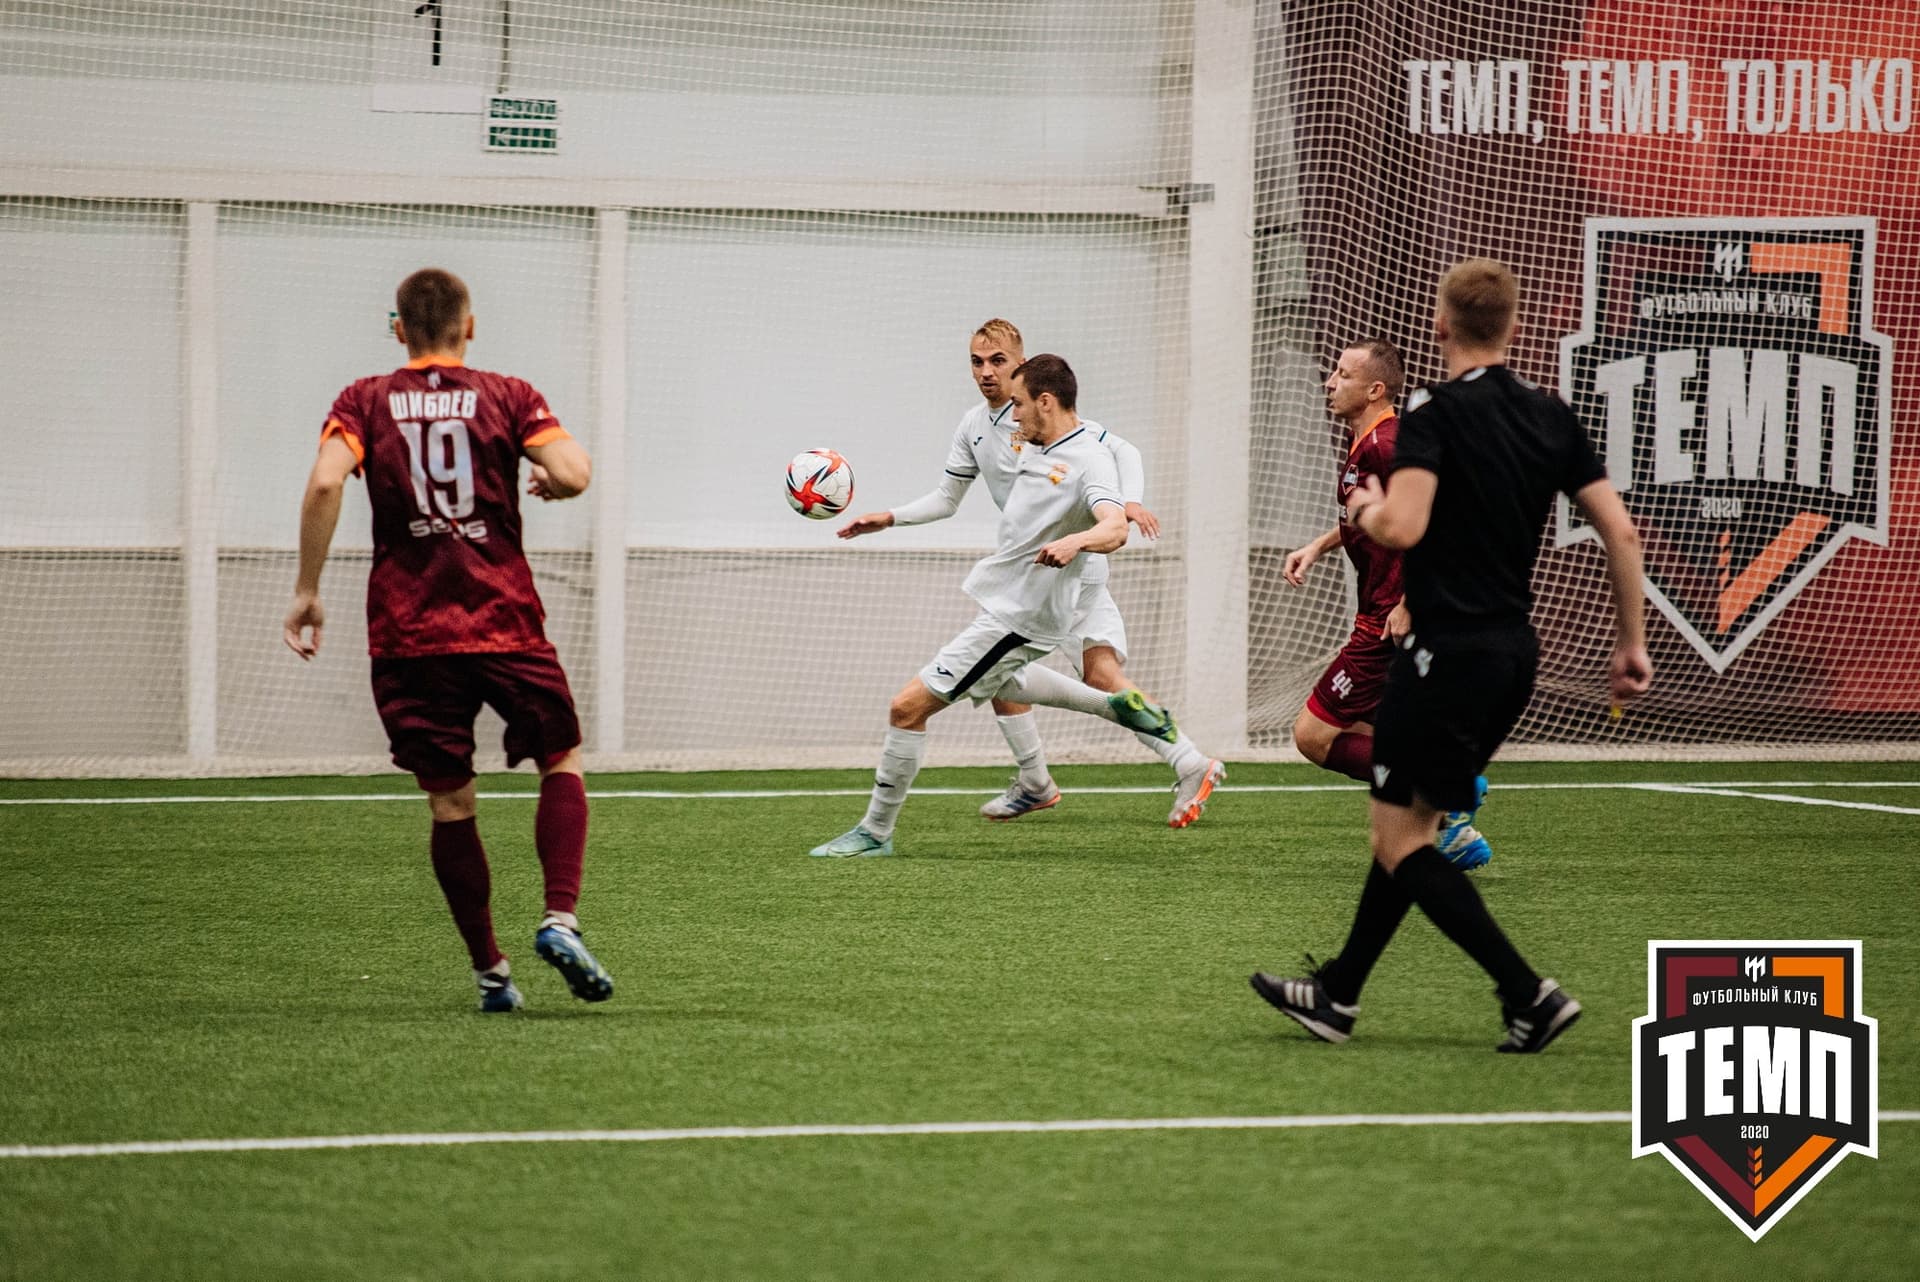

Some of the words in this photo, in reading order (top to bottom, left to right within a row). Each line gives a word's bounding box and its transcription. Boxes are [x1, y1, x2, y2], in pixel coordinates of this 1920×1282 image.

[413, 0, 442, 66] 1
[1403, 59, 1545, 143] ТЕМП,
[1562, 59, 1704, 143] ТЕМП,
[1721, 57, 1913, 134] ТОЛЬКО
[1640, 288, 1760, 319] ФУТБОЛЬНЫЙ
[1765, 291, 1813, 320] КЛУБ
[388, 390, 479, 421] ШИБАЕВ
[1595, 346, 1859, 497] ТЕМП
[396, 419, 475, 520] 19
[1700, 497, 1744, 519] 2020
[1331, 669, 1354, 700] 44
